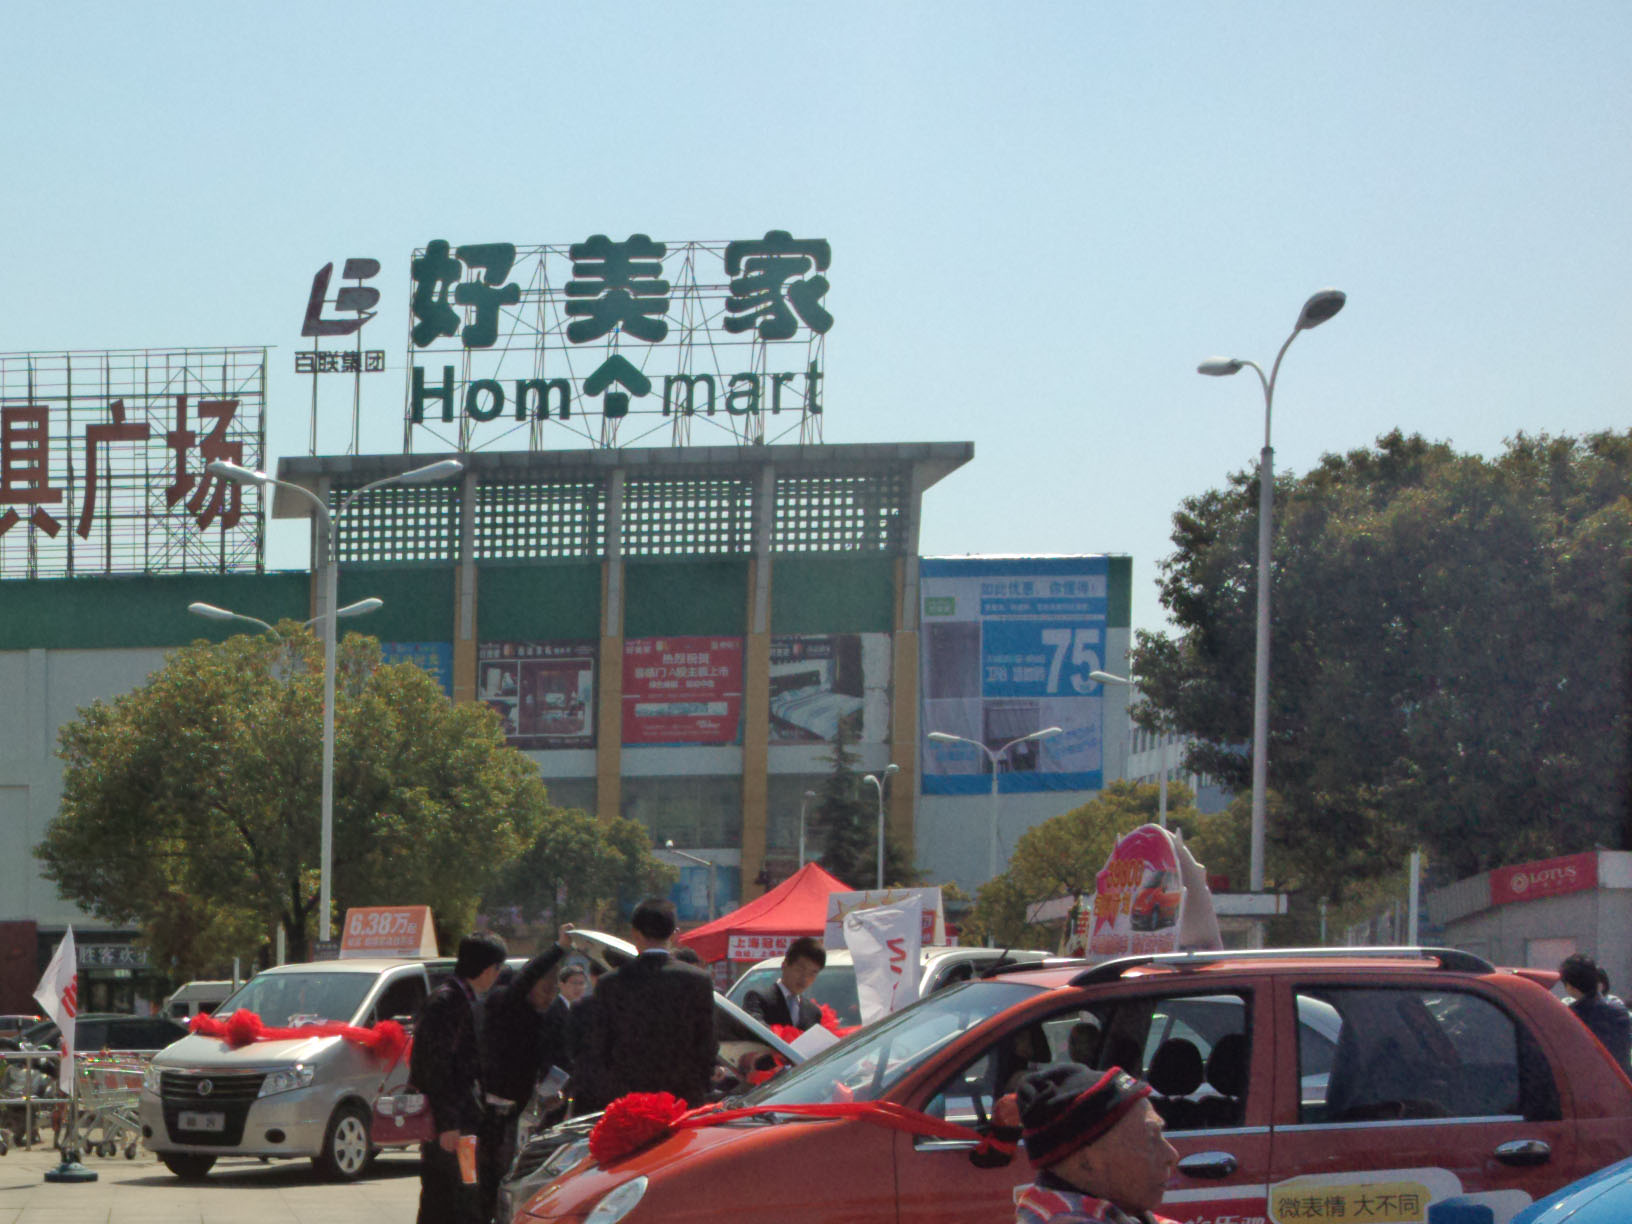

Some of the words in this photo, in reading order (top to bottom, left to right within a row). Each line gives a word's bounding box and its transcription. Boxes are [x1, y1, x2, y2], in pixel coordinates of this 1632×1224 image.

[411, 230, 834, 348] 好美家
[294, 350, 386, 374] 百联集团
[1279, 1197, 1346, 1219] 微表情
[1352, 1193, 1420, 1217] 大不同
